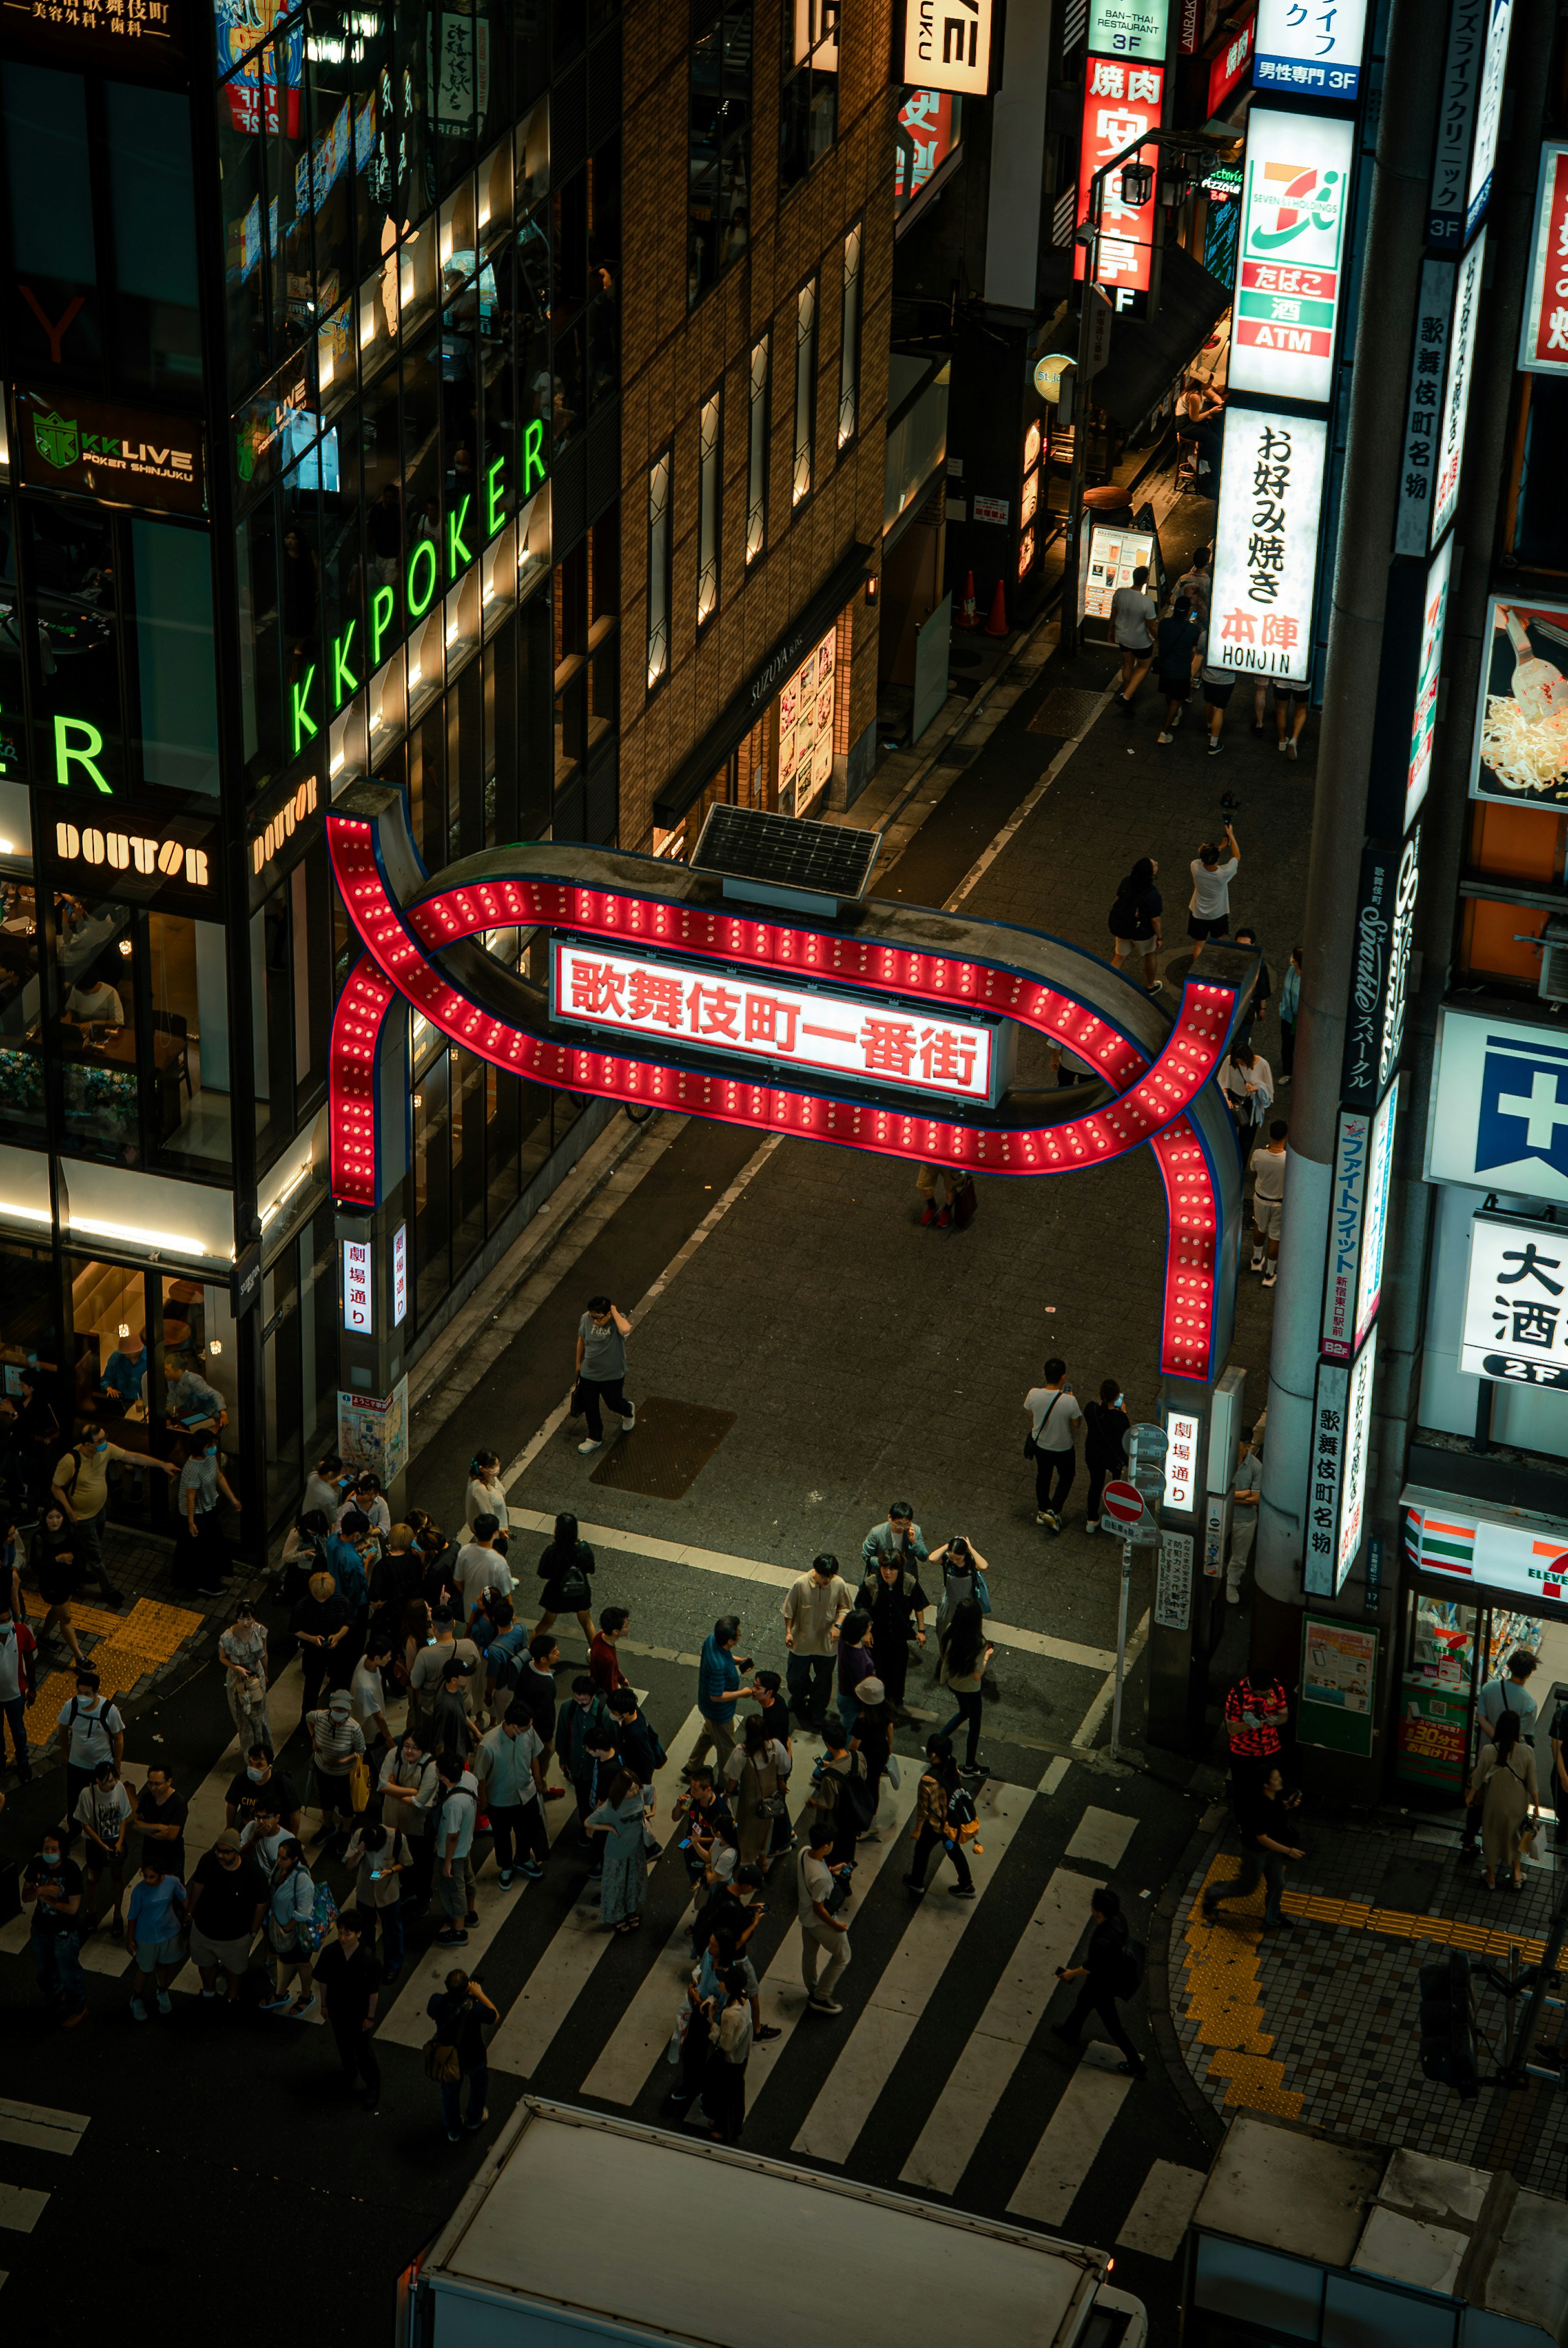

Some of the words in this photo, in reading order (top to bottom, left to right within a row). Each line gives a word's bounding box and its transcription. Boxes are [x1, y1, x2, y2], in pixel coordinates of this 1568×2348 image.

[1098, 19, 1159, 34] RESTAURANT
[1105, 10, 1154, 24] BAN-THAI
[1315, 0, 1337, 56] イフ
[1113, 34, 1142, 51] 3F
[1090, 62, 1160, 104] 焼肉
[1259, 62, 1324, 87] 男性専門
[1329, 72, 1356, 89] 3F
[1254, 194, 1281, 205] SEVEN
[1292, 200, 1337, 213] HOLDINGS
[1430, 219, 1459, 237] 3F
[1254, 266, 1322, 295] たばこ
[1271, 297, 1302, 321] 酒
[1254, 326, 1312, 352] ATM
[1405, 317, 1444, 499] 歌舞伎町名物
[82, 452, 126, 469] POKER
[131, 463, 193, 482] SHINJUKU
[1247, 426, 1292, 604] お好み焼き
[1221, 607, 1299, 651] 本陣
[1223, 644, 1290, 674] HONJIN
[253, 775, 317, 875] DOUTOR
[56, 822, 209, 886] DOUTOR
[571, 957, 977, 1086] 歌舞伎町一番街
[1348, 1016, 1374, 1088] スパークル
[1337, 1137, 1364, 1274] ファイトフィット
[350, 1246, 366, 1324] 劇場通り
[396, 1233, 404, 1315] 劇場通り
[1332, 1276, 1348, 1337] 新宿東口駅前
[1325, 1340, 1348, 1357] B2F
[1504, 1360, 1561, 1383] 2F
[1172, 1422, 1192, 1503] 劇場通り
[1312, 1409, 1340, 1555] 歌舞伎町名物
[1105, 1519, 1139, 1540] 自転車を除く
